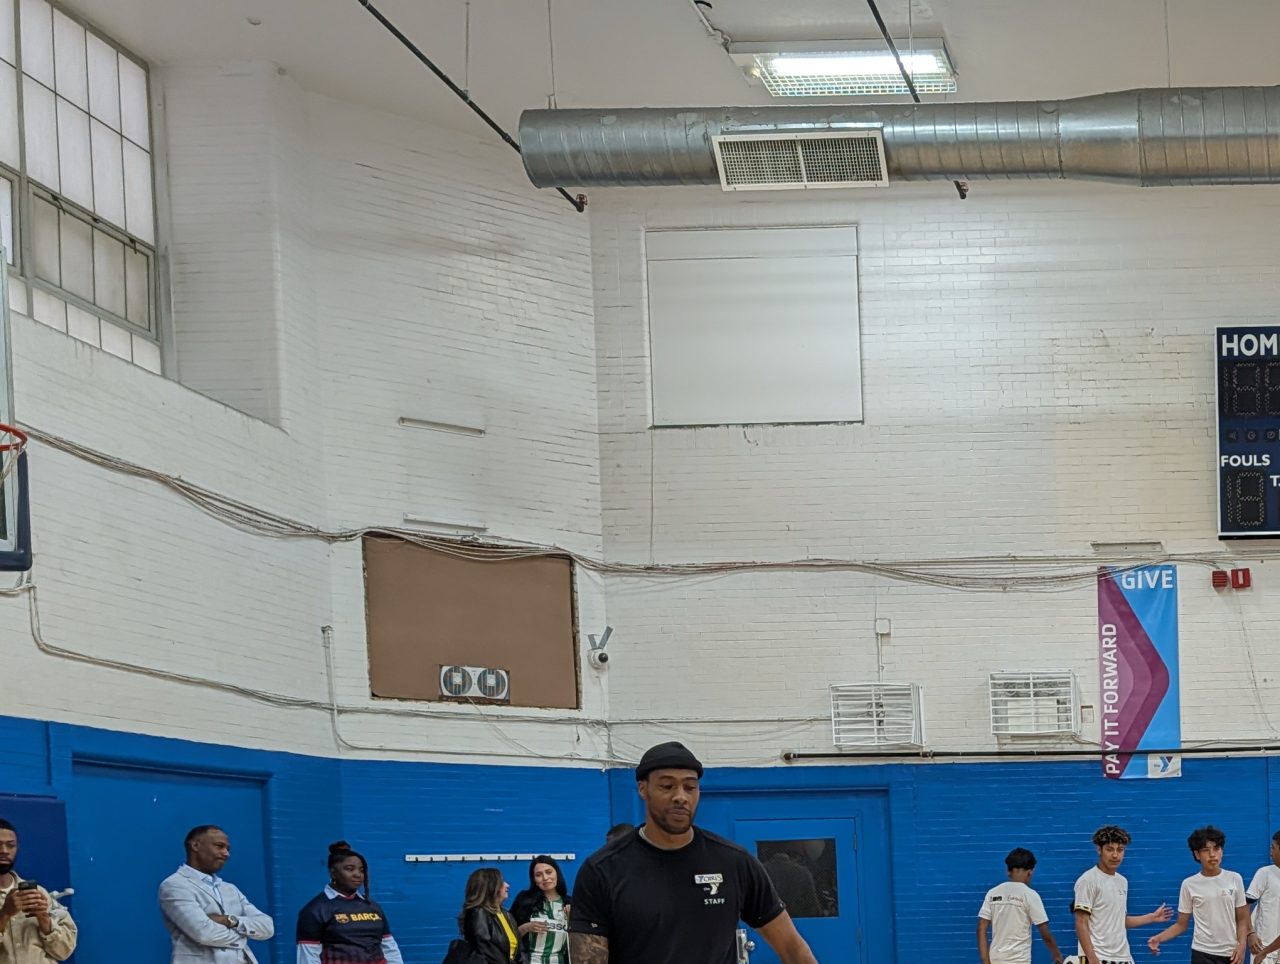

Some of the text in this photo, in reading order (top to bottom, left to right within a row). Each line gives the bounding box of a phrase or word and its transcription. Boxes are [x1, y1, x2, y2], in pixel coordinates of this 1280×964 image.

[1220, 454, 1271, 467] FOULS
[1121, 570, 1173, 589] GIVE
[1101, 623, 1120, 774] PAY IT FORWARD
